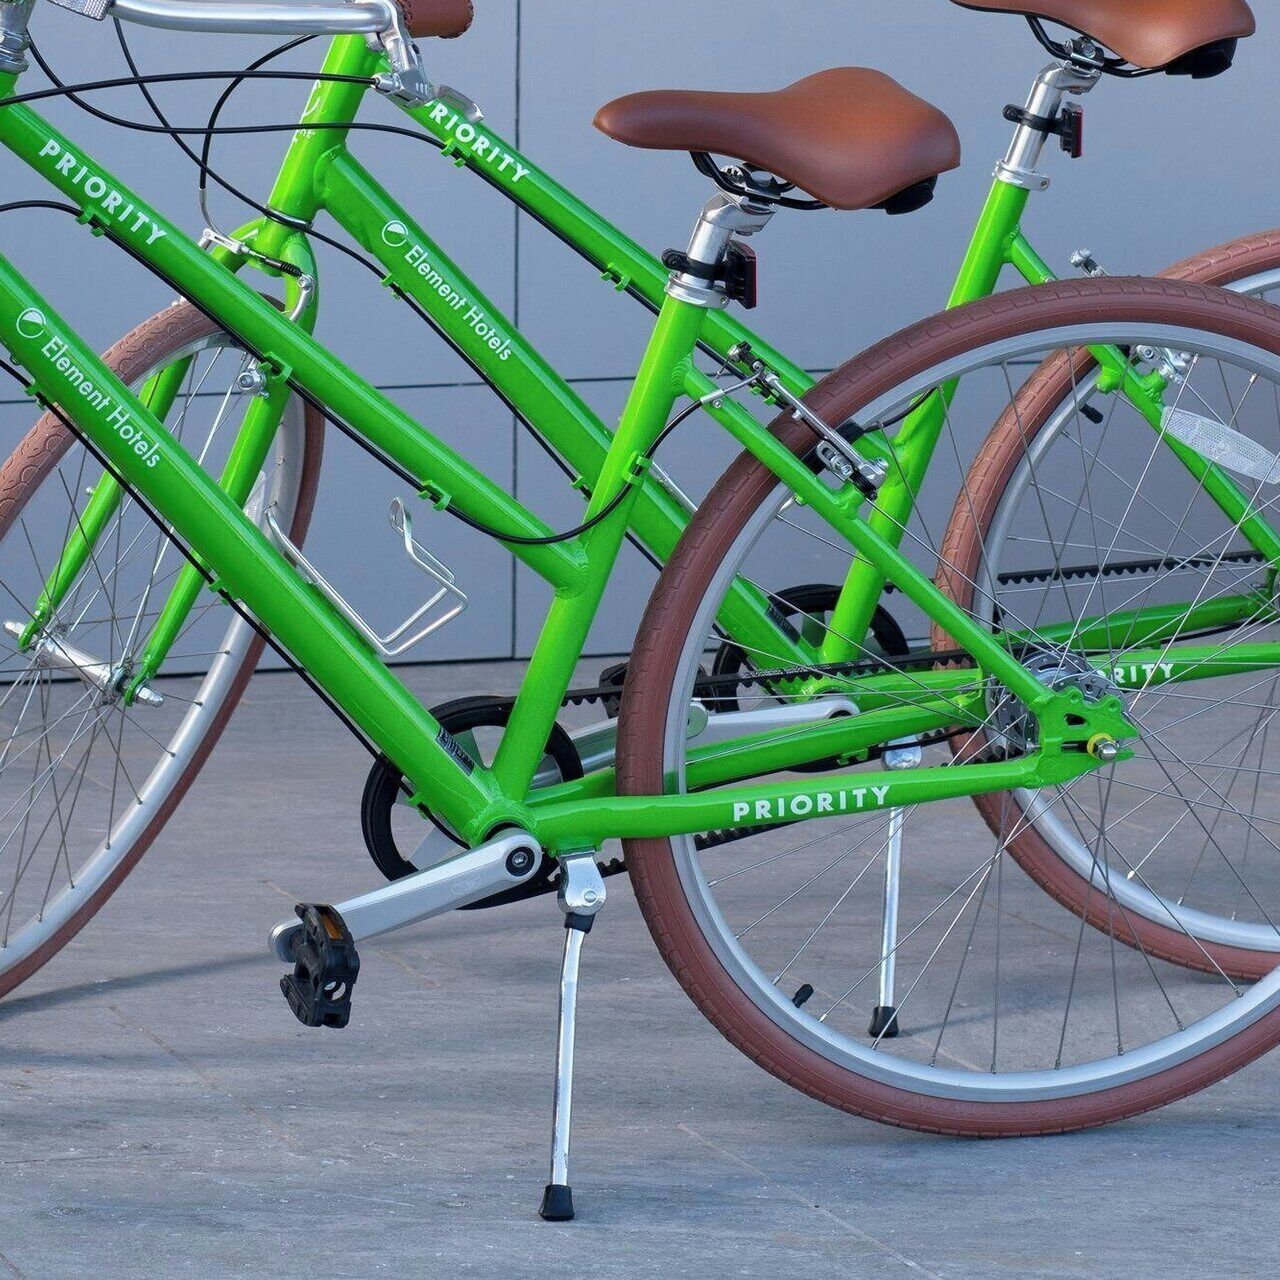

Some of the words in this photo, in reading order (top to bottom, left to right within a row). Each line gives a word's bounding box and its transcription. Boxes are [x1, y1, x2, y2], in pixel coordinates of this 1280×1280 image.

[39, 138, 167, 246] PRIORITY
[404, 244, 467, 311] Element
[462, 305, 512, 361] Hotels
[40, 335, 111, 410] Element
[106, 405, 161, 468] Hotels
[733, 785, 891, 822] PRIORITY
